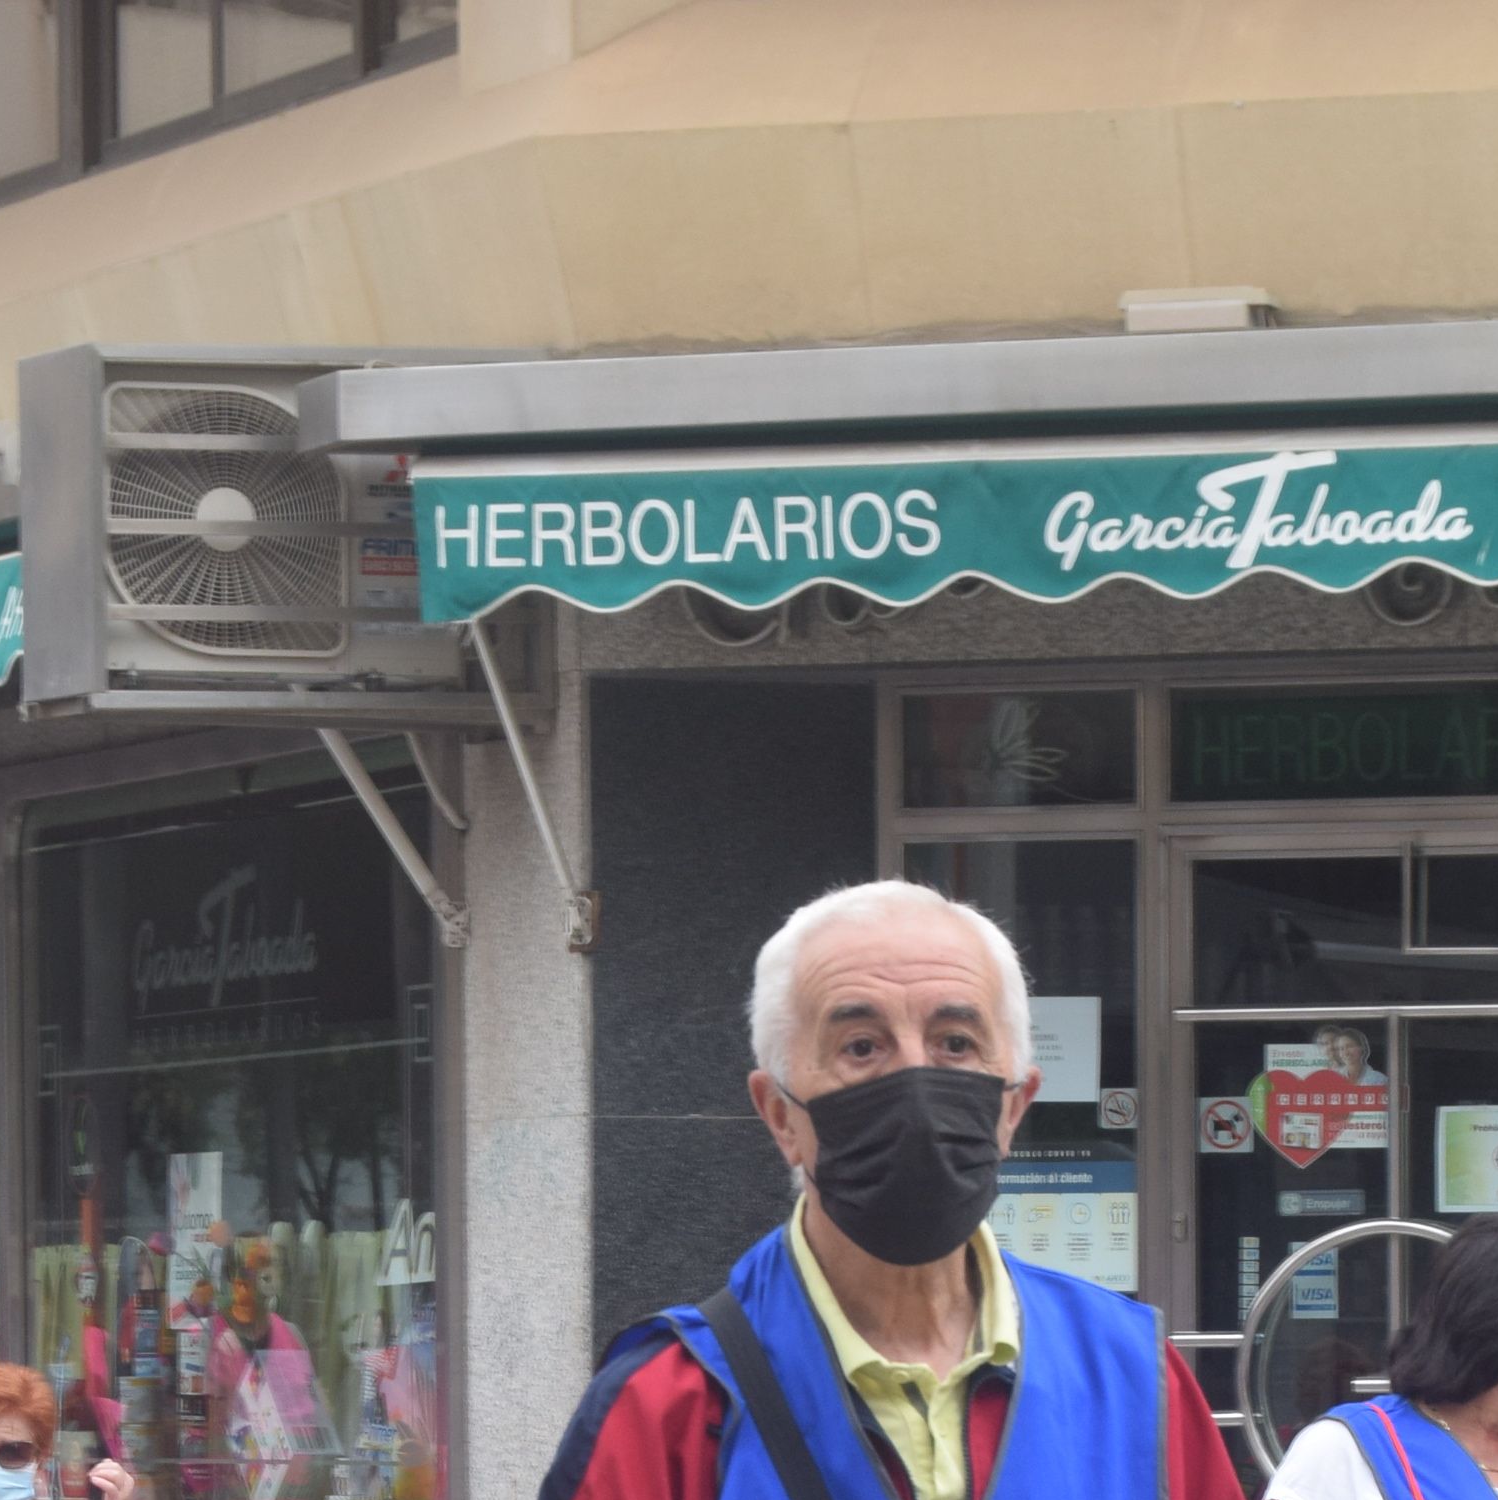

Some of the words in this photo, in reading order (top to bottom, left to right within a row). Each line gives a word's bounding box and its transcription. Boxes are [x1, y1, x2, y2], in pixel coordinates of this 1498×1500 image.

[435, 490, 942, 569] HERBOLARIOS
[1197, 449, 1474, 569] Taboada
[997, 1172, 1046, 1184] ormación
[1301, 1289, 1333, 1300] VISA
